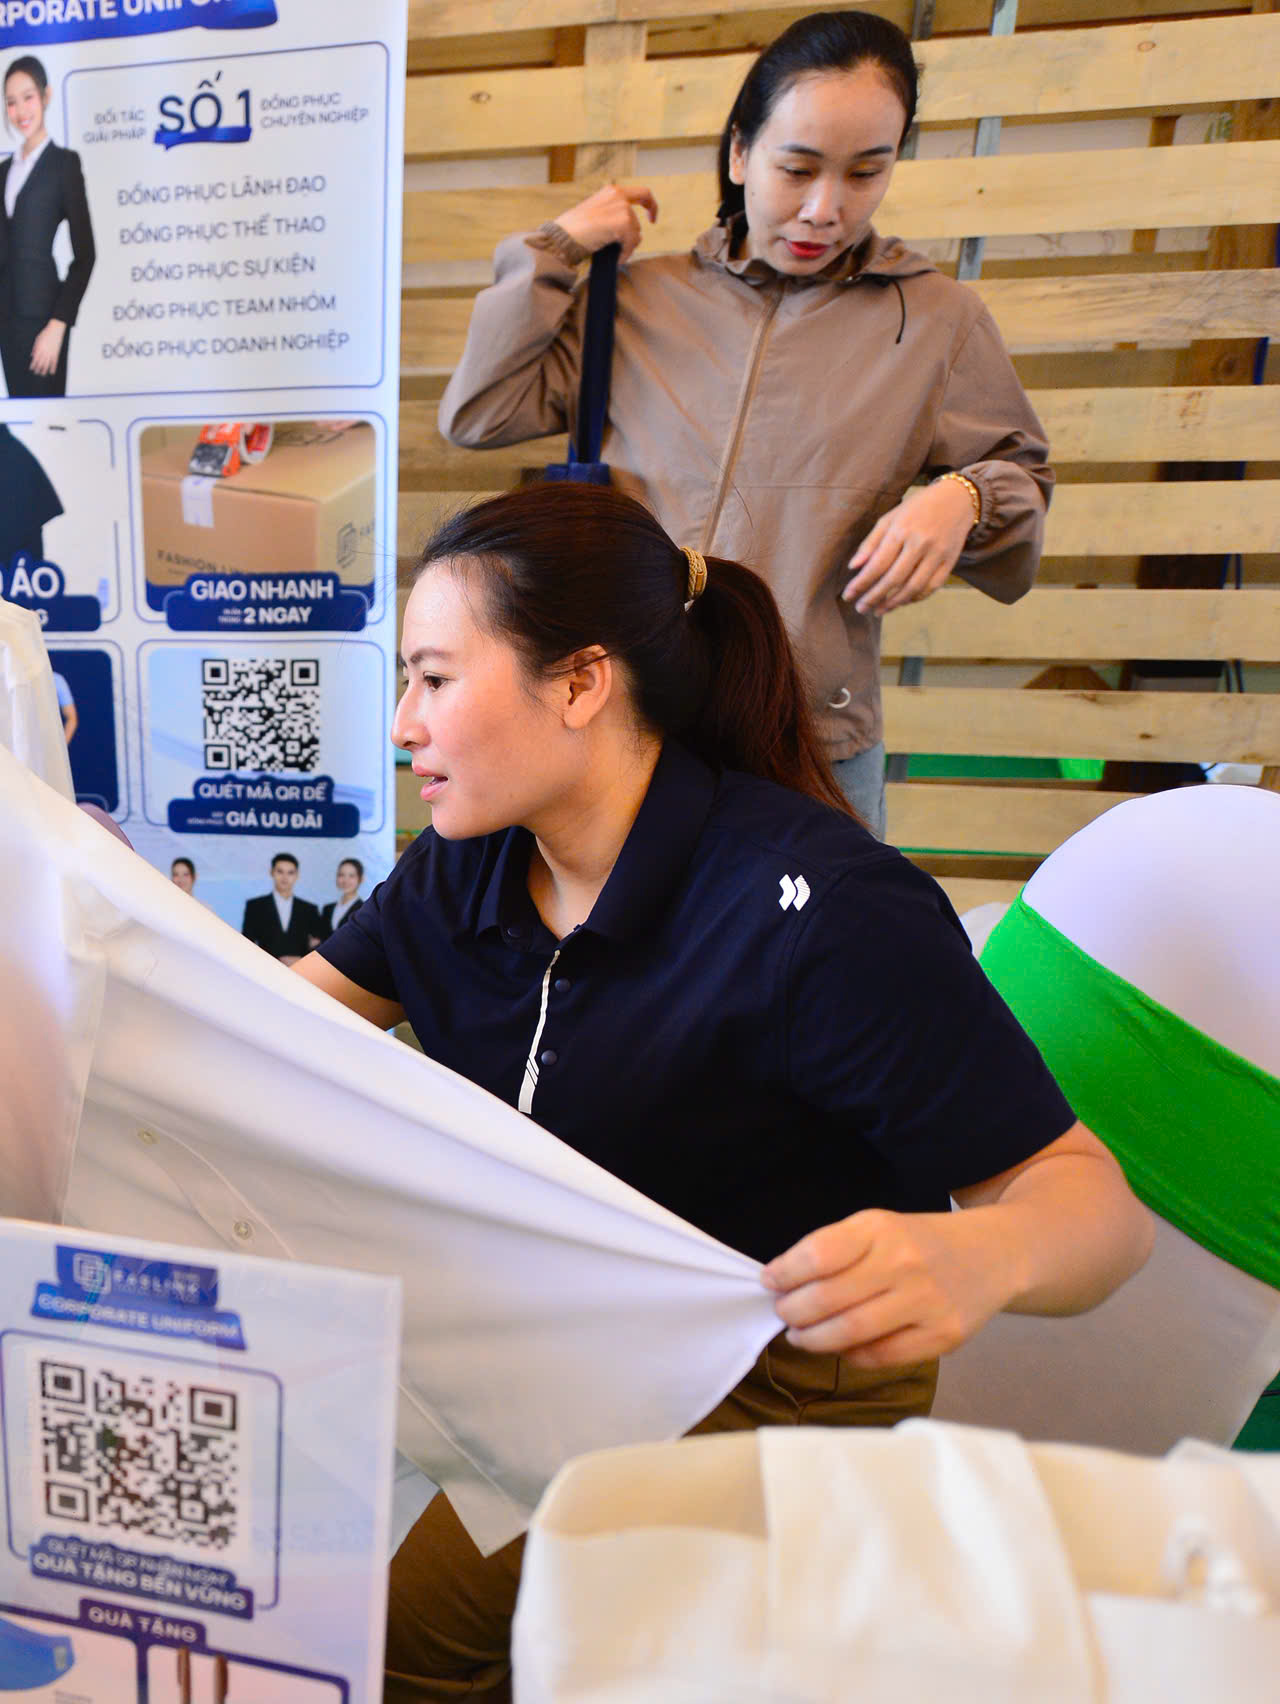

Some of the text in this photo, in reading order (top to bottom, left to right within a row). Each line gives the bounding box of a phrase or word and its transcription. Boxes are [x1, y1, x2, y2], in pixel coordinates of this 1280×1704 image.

[158, 70, 251, 133] SỐ 1
[174, 182, 227, 205] PHỤC
[231, 175, 282, 199] LÃNH
[285, 175, 327, 197] ĐẠO
[176, 222, 228, 244] PHỤC
[273, 215, 326, 235] THAO
[187, 261, 239, 283] PHỤC
[273, 252, 316, 276] KIỆN
[169, 300, 221, 321] PHỤC
[224, 297, 275, 317] TEAM
[278, 290, 337, 313] NHÓM
[157, 338, 208, 360] PHỤC
[211, 335, 277, 355] DOANH
[280, 328, 350, 354] NGHIỆP
[9, 557, 61, 599] ÁO
[190, 578, 334, 601] GIAO NHANH
[243, 606, 257, 624] 2
[199, 780, 245, 800] QUÉT
[247, 782, 273, 800] MÃ
[275, 785, 301, 801] QR
[226, 808, 258, 827] GIÁ
[291, 809, 323, 829] ĐÃI
[38, 1293, 238, 1338] CORPORATE UNIFORM
[33, 1551, 78, 1577] QUÀ
[80, 1561, 138, 1588] TẶNG
[88, 1606, 198, 1643] QUÀ TẶNG
